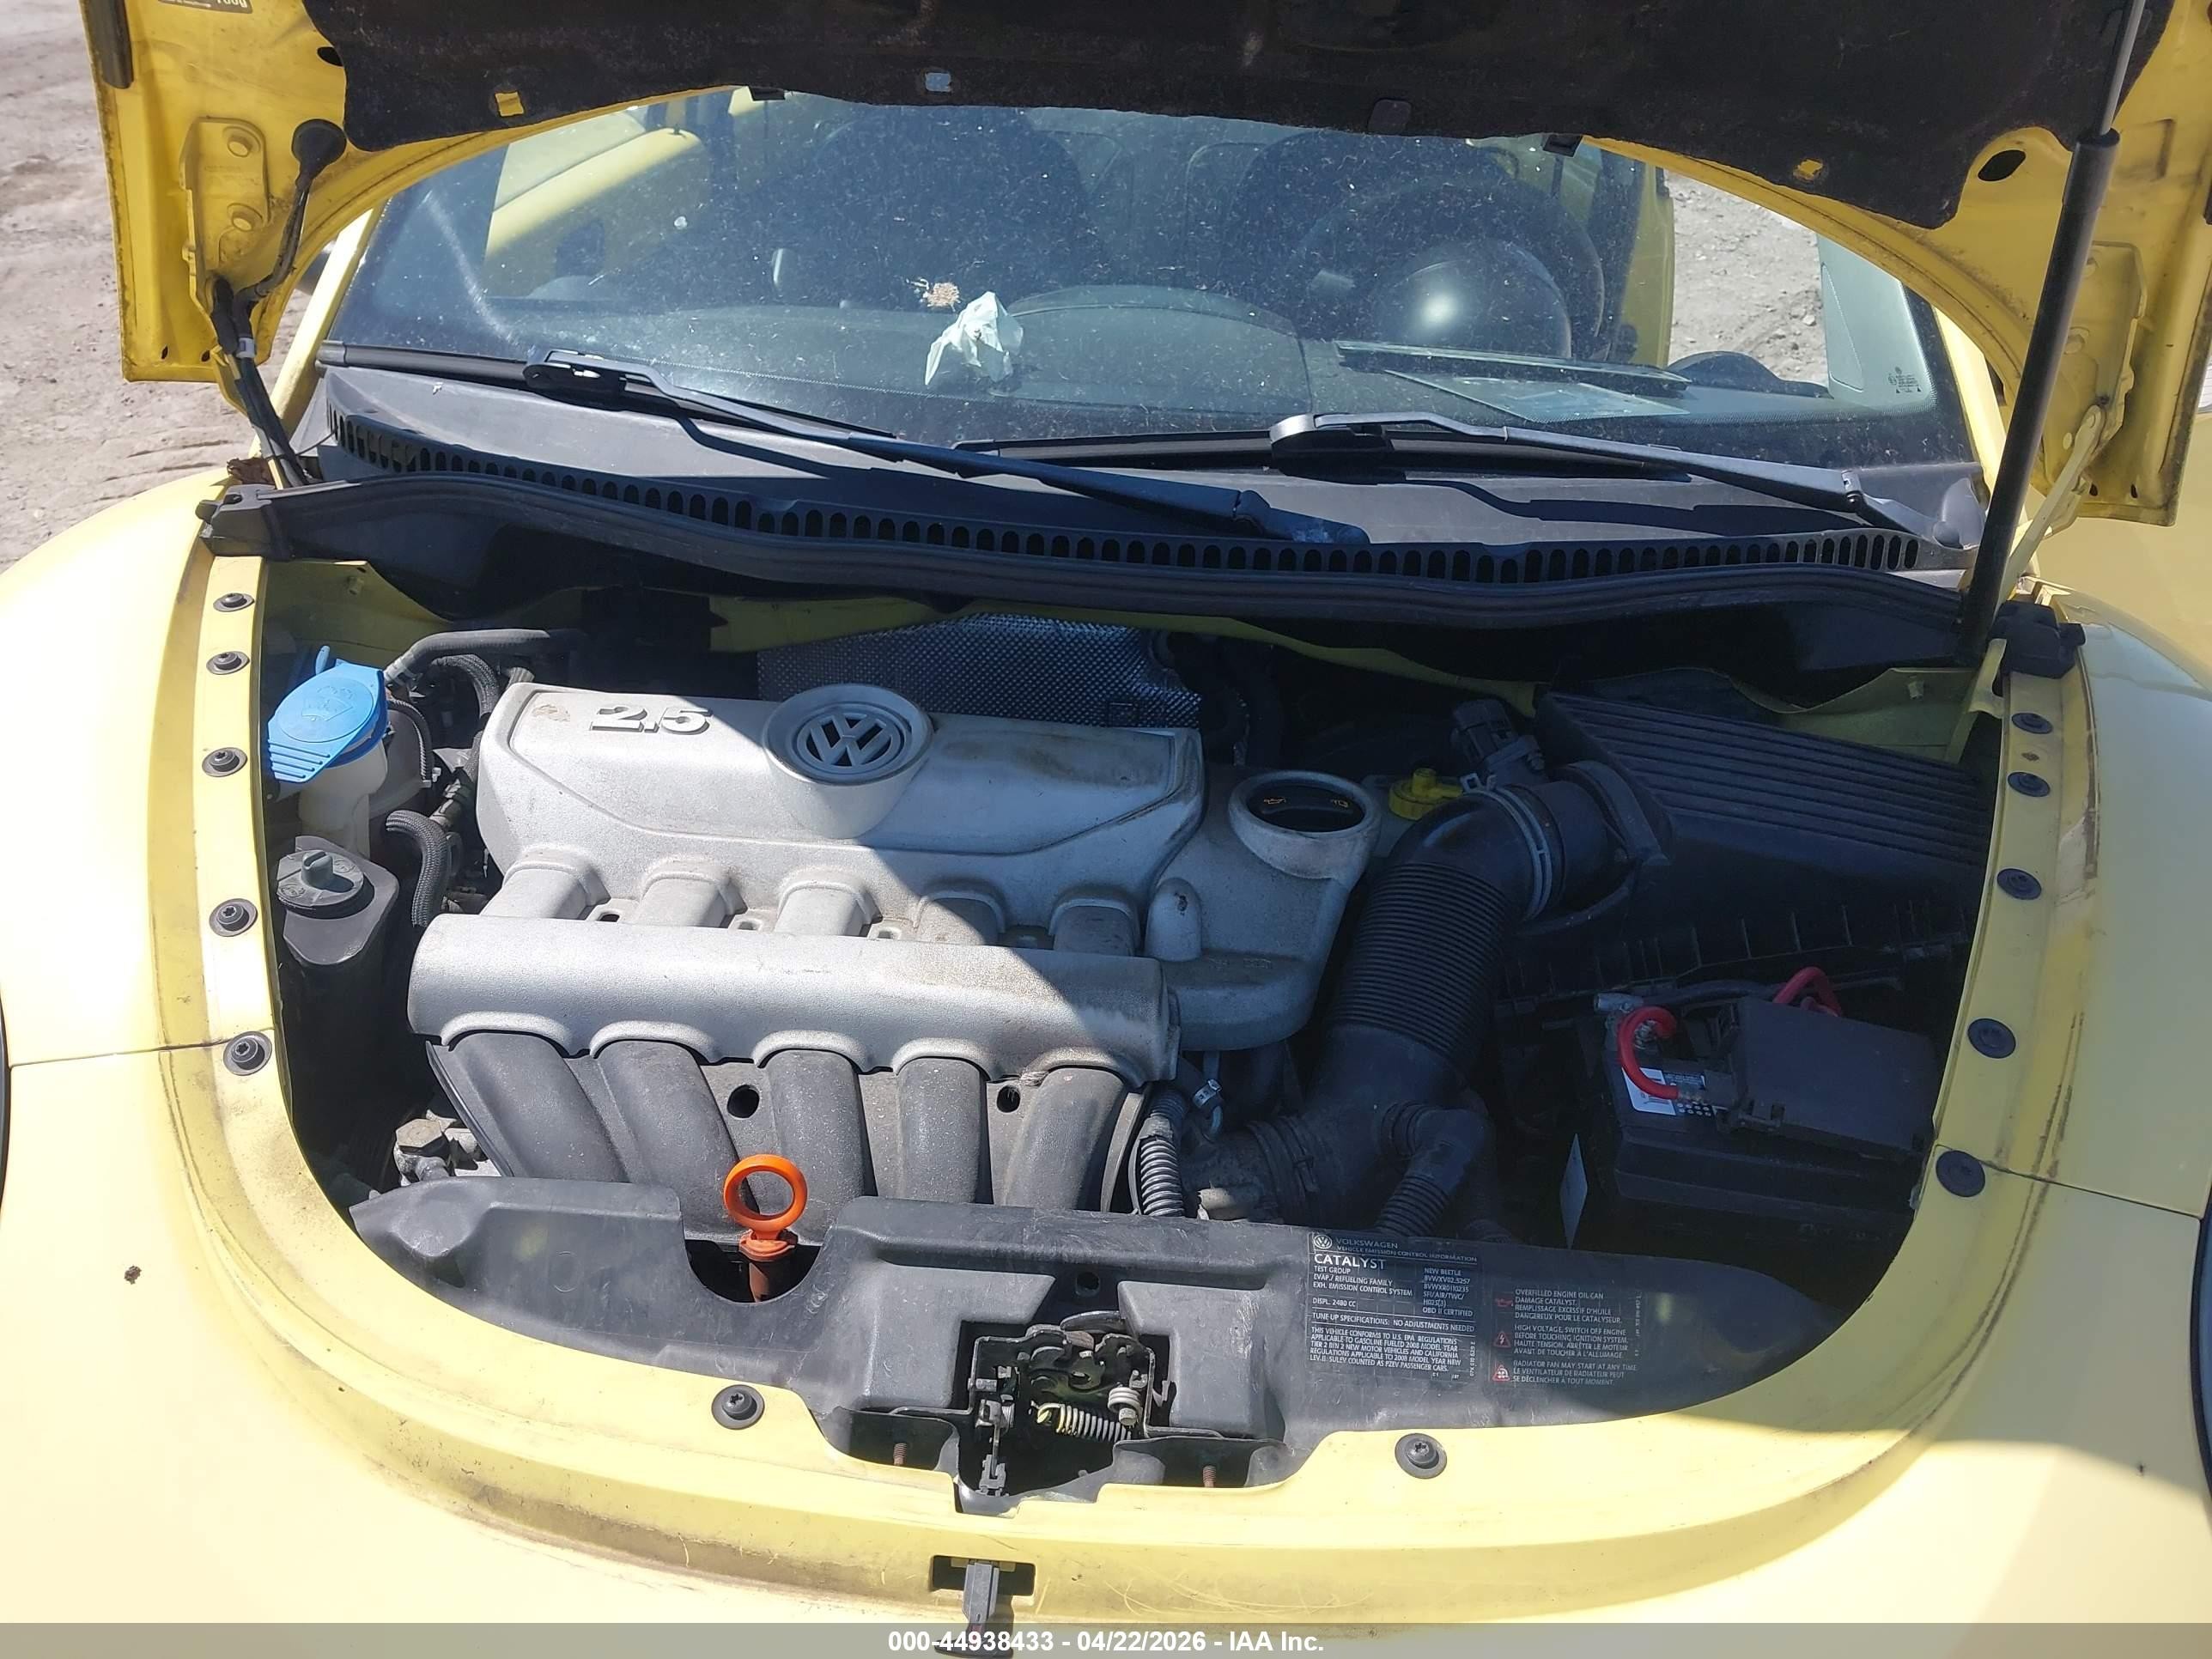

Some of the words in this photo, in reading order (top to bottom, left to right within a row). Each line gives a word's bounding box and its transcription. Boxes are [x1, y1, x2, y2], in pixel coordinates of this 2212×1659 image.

[590, 705, 713, 735] 2.5
[1337, 1238, 1398, 1249] VOLKSWAGEN
[1315, 1254, 1387, 1269] CATALYST
[1430, 1253, 1477, 1261] INFORMATION
[1335, 1275, 1367, 1284] REFUELING
[1404, 1321, 1449, 1330] ADJUSTMENTS
[1311, 1334, 1346, 1342] APPLICABLE
[1355, 1337, 1382, 1346] GASOLINE
[1418, 1336, 1457, 1345] REGULATIONS
[1310, 1347, 1350, 1357] REGULATIONS
[1351, 1351, 1383, 1359] APPLICABLE
[1384, 1346, 1409, 1355] VEHICLES
[1425, 1350, 1459, 1358] CALIFORNIA
[1401, 1361, 1431, 1370] PASSENGER
